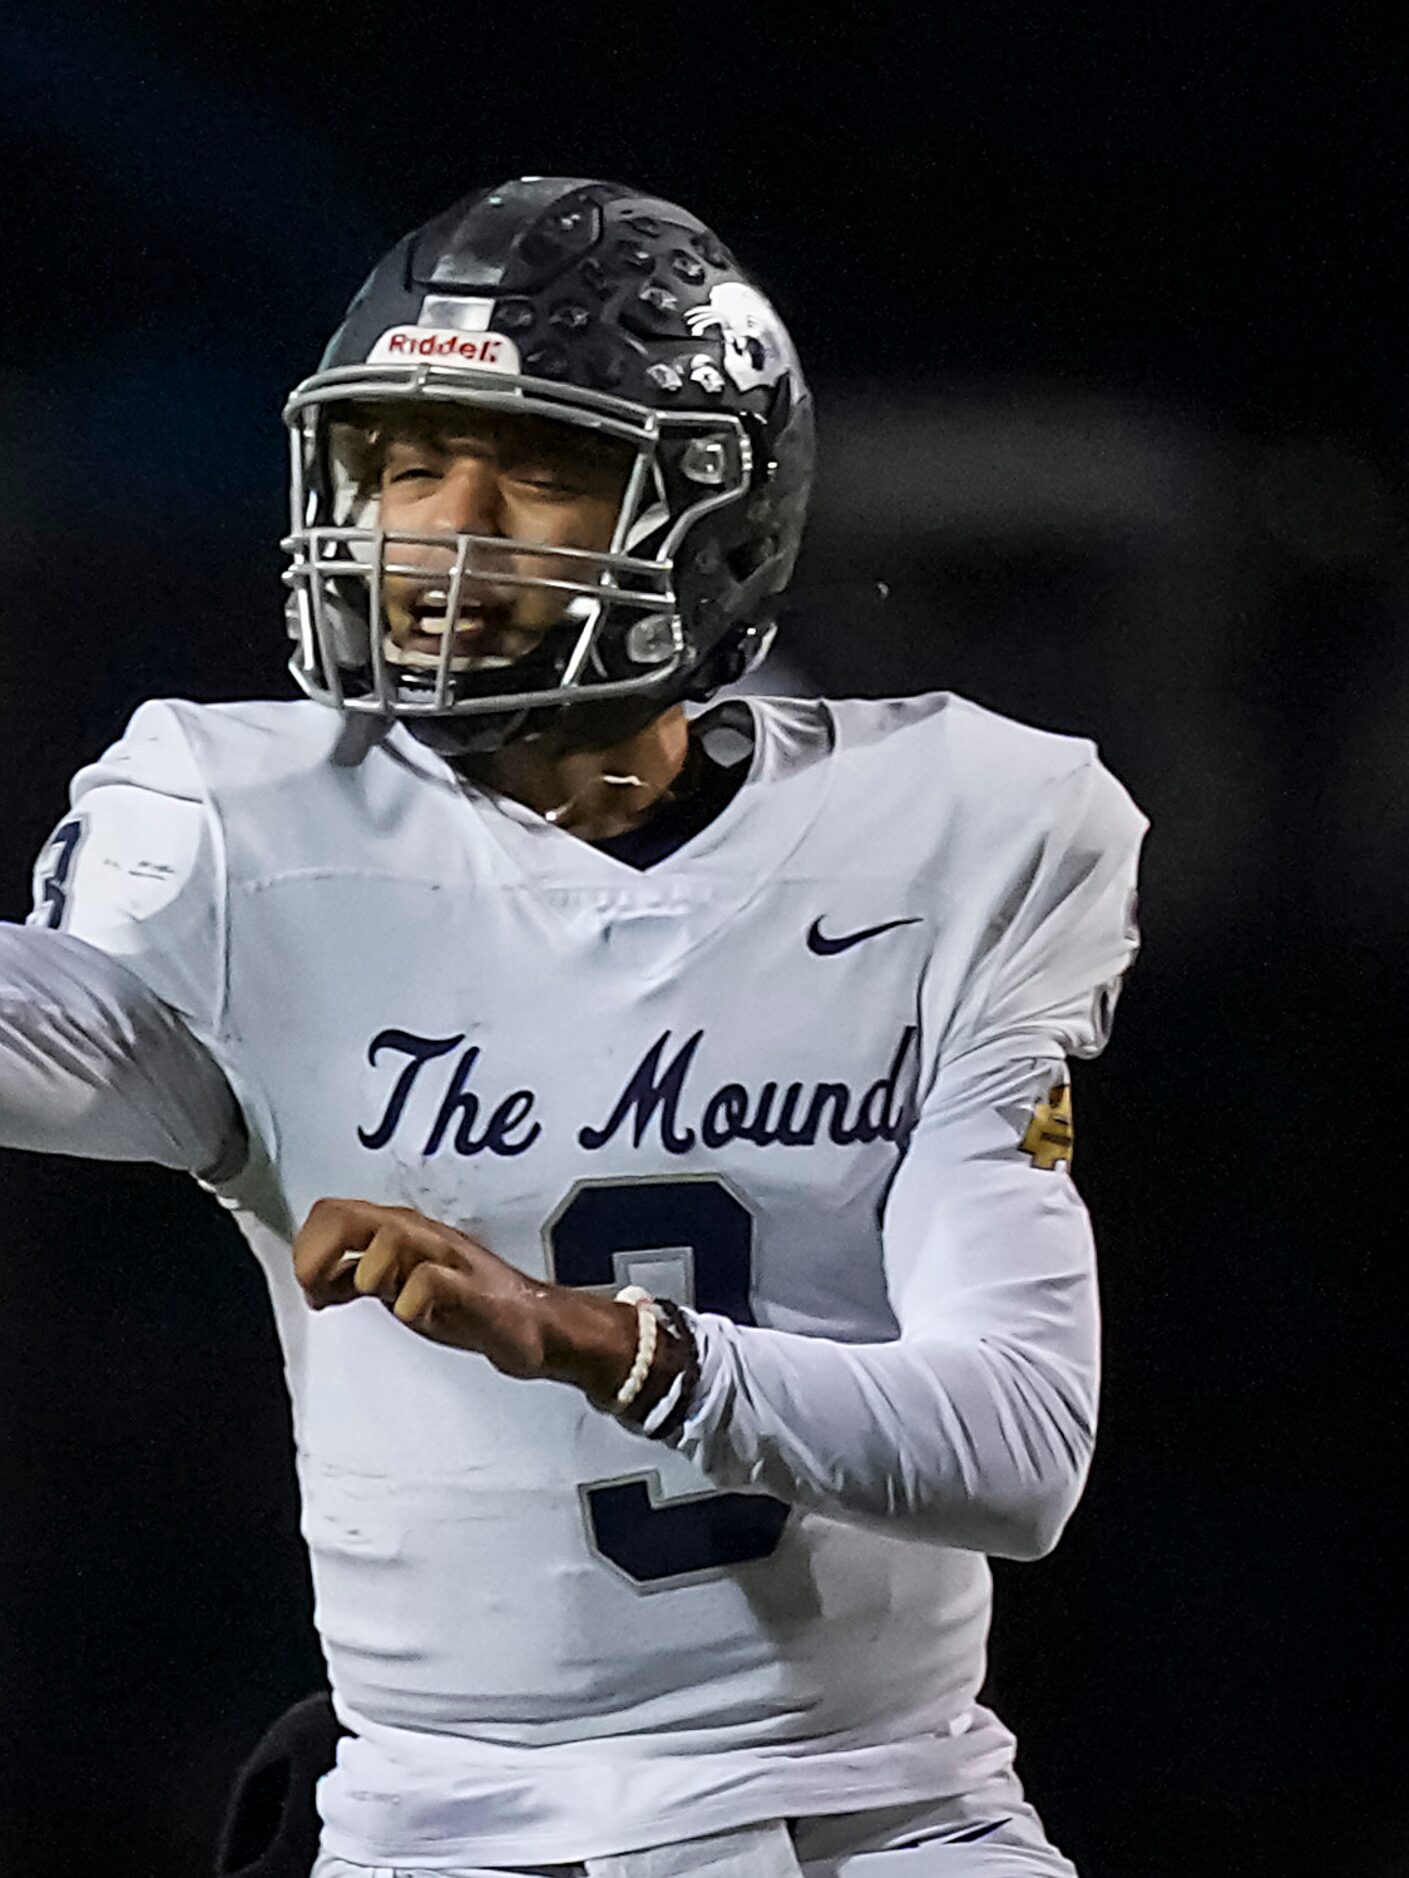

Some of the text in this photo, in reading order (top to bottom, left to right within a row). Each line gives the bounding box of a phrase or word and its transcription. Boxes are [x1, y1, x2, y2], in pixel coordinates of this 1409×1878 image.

[357, 1028, 542, 1157] The
[577, 1026, 920, 1155] Mound
[540, 1172, 793, 1597] 3
